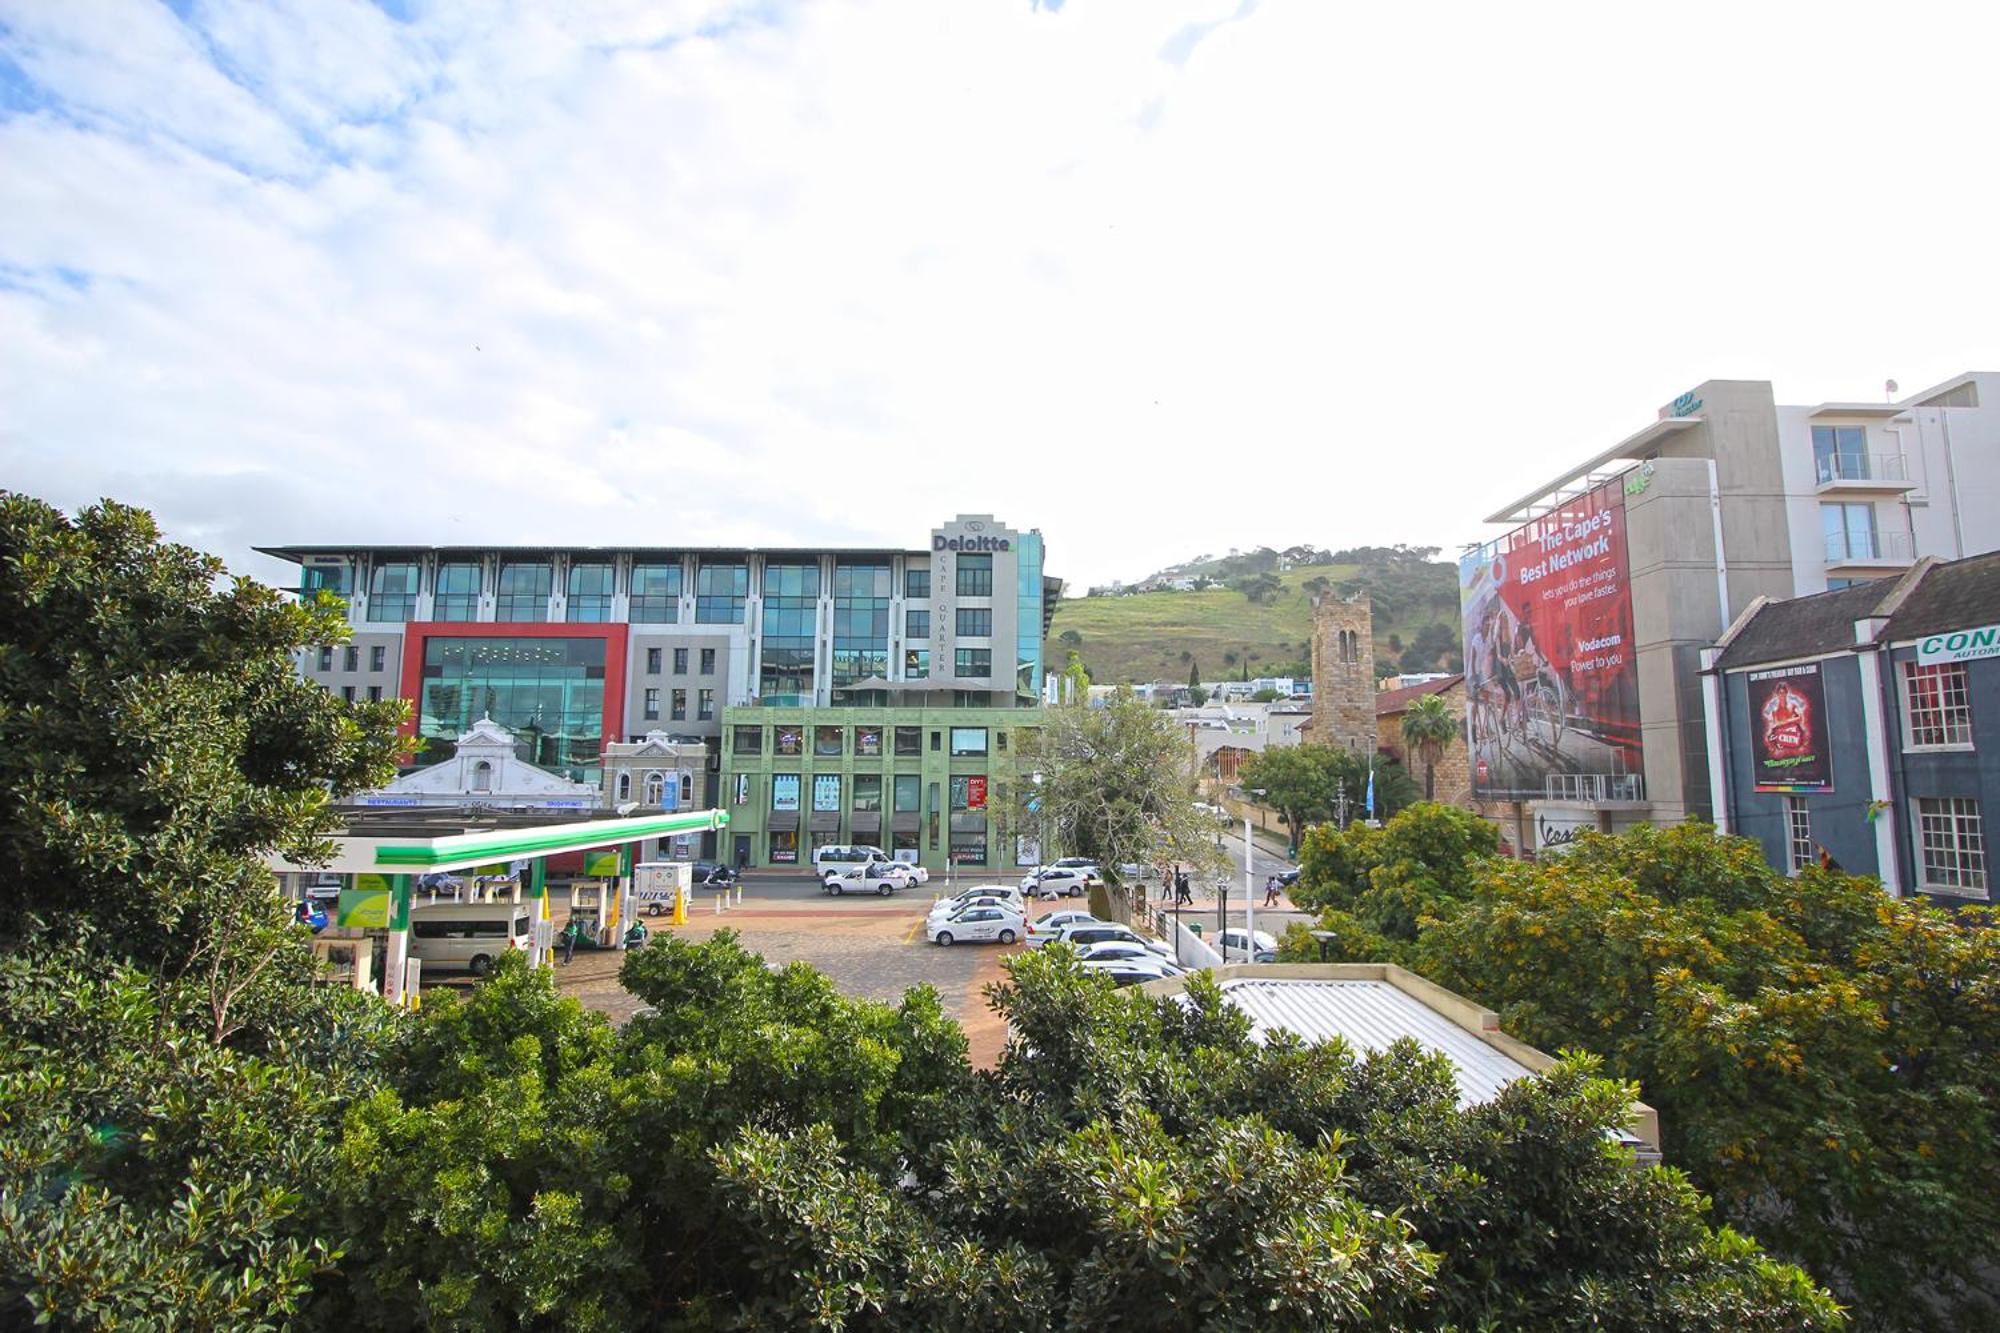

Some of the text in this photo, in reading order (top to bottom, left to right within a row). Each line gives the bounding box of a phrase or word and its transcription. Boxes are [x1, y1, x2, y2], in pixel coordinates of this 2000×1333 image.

[1562, 509, 1612, 542] Cape's
[933, 535, 1010, 552] Deloitte
[1520, 534, 1609, 585] Best Network
[1592, 567, 1617, 584] things
[938, 604, 948, 672] QUARTER
[1578, 634, 1621, 653] Vodacom
[1922, 628, 2000, 655] CON
[1570, 653, 1622, 673] Power to you
